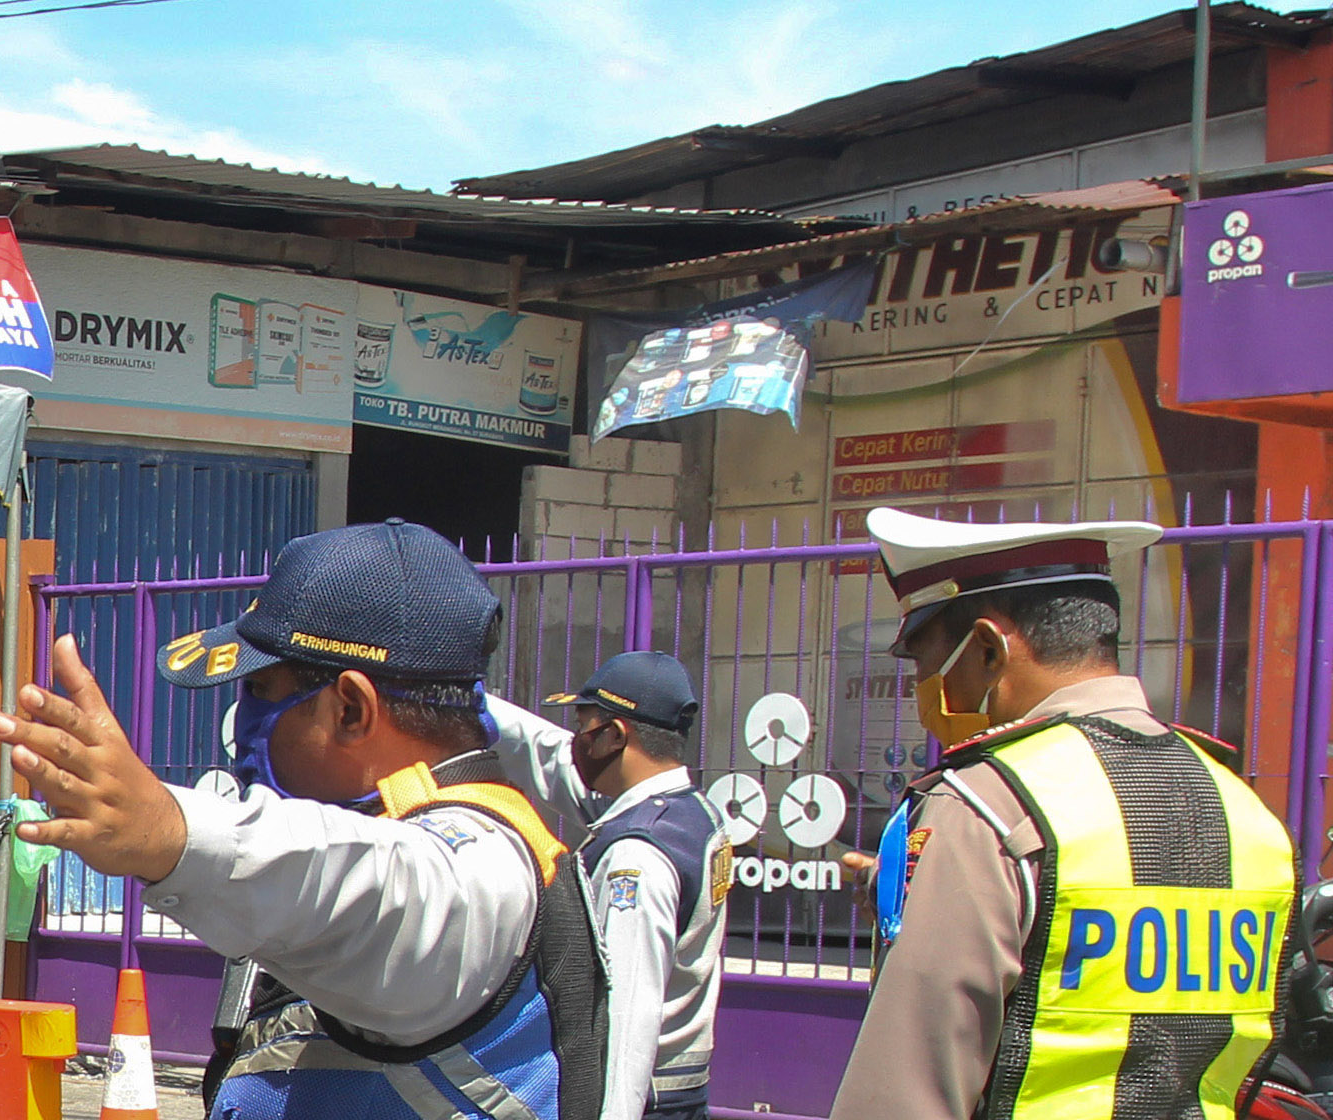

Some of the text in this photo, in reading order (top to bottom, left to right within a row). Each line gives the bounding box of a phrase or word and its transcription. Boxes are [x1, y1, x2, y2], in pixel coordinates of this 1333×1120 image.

[1207, 263, 1263, 284] propan
[984, 295, 999, 317] &
[1036, 281, 1117, 311] CEPAT
[55, 352, 156, 371] MORTAR BERKUALITAS!
[359, 395, 546, 440] TOKO TB. PUTRA MAKMUR
[840, 438, 897, 463] Cepat
[838, 474, 895, 497] Cepat
[290, 631, 389, 663] PERHUBUNGAN
[730, 856, 842, 893] ropan
[1059, 906, 1277, 995] POLISI
